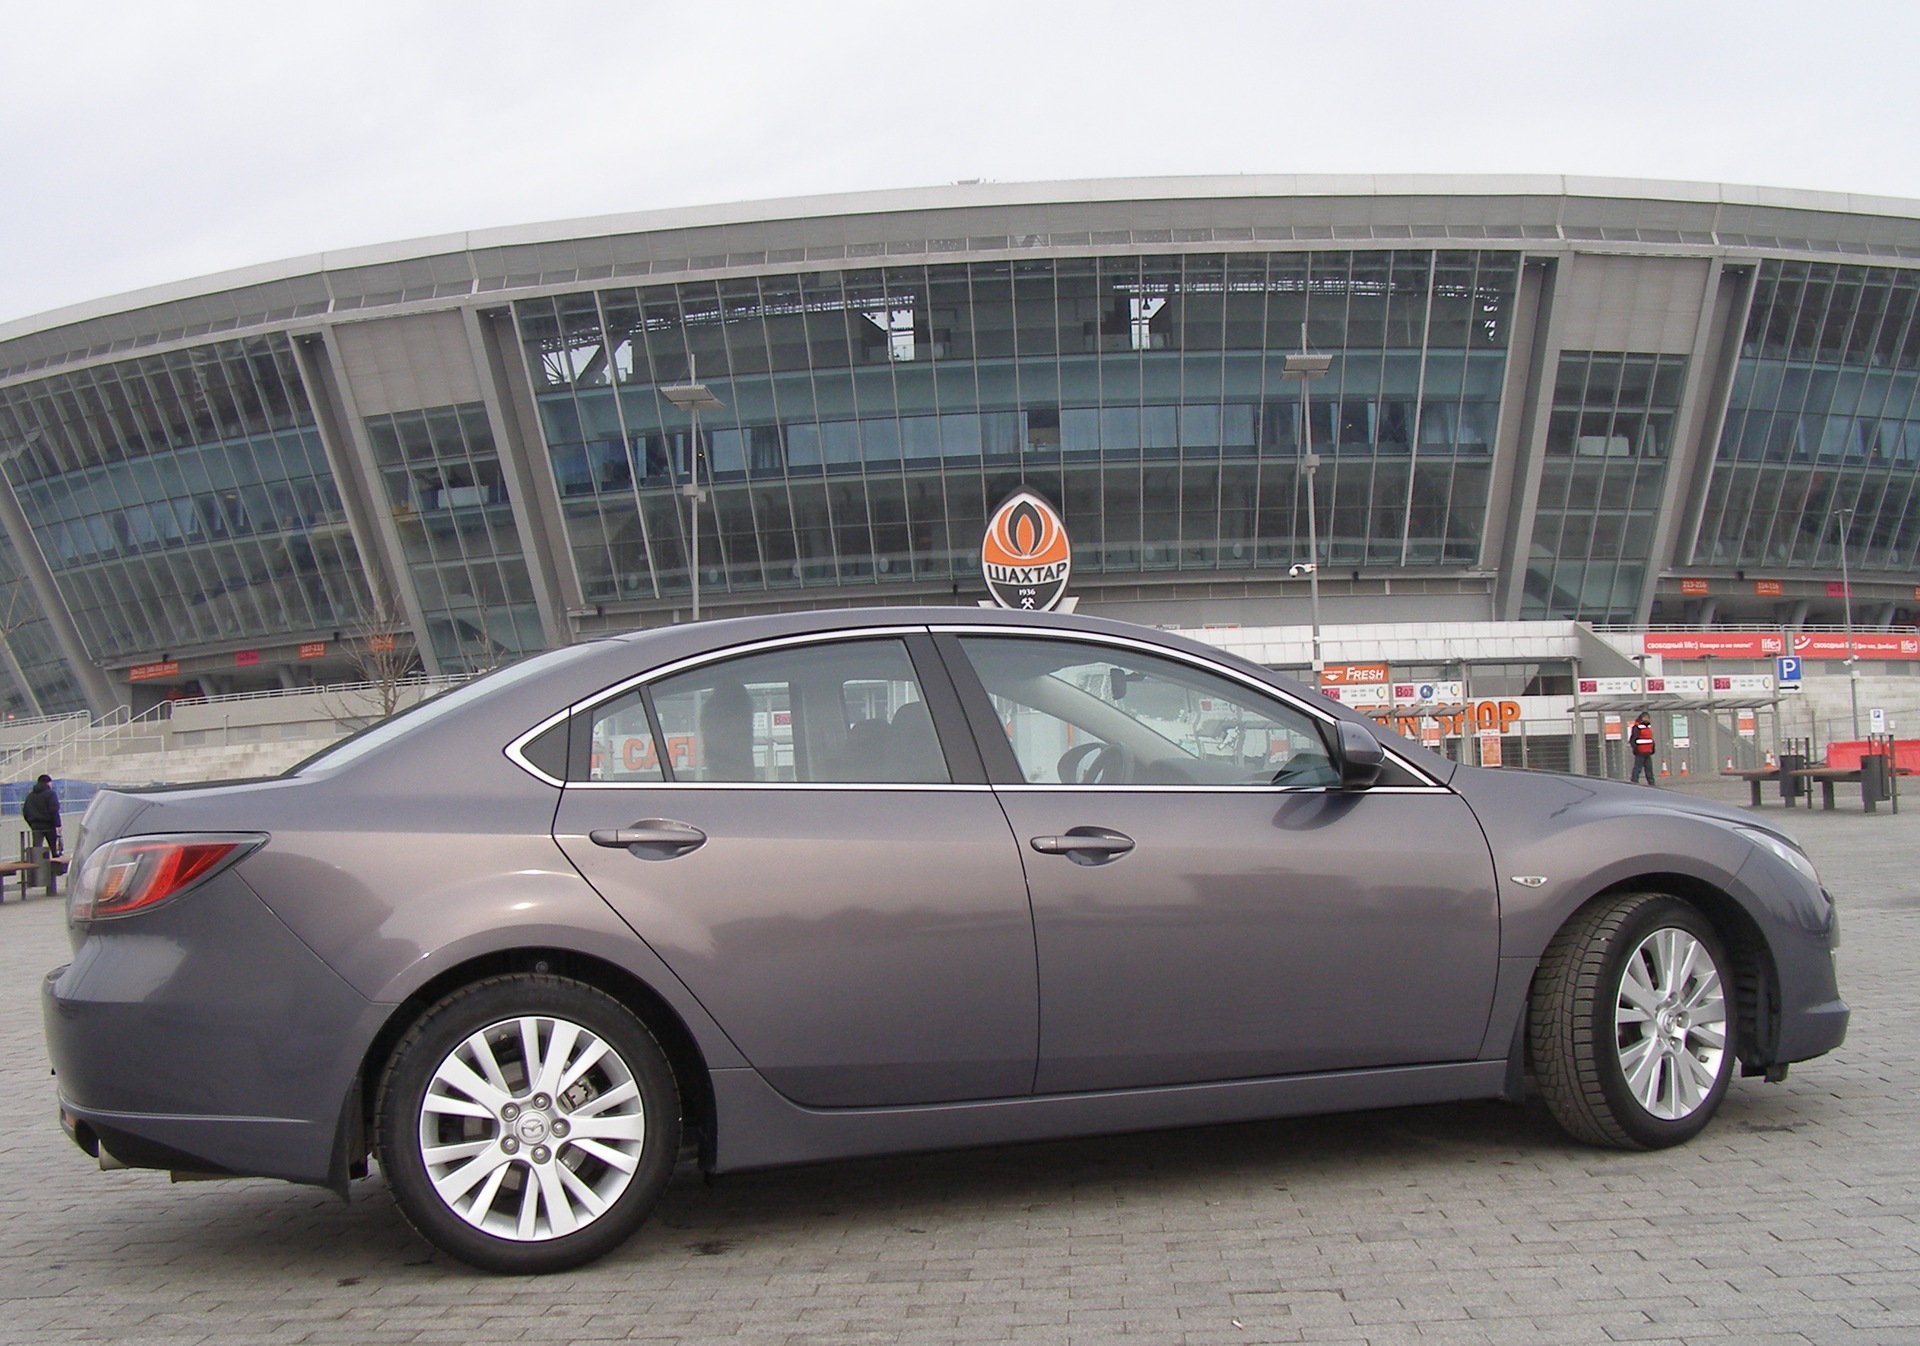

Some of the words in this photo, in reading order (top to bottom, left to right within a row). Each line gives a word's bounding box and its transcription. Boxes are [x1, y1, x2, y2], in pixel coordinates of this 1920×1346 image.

[987, 562, 1067, 583] ШАХТАР
[1018, 588, 1036, 596] 1936
[1782, 659, 1797, 679] P
